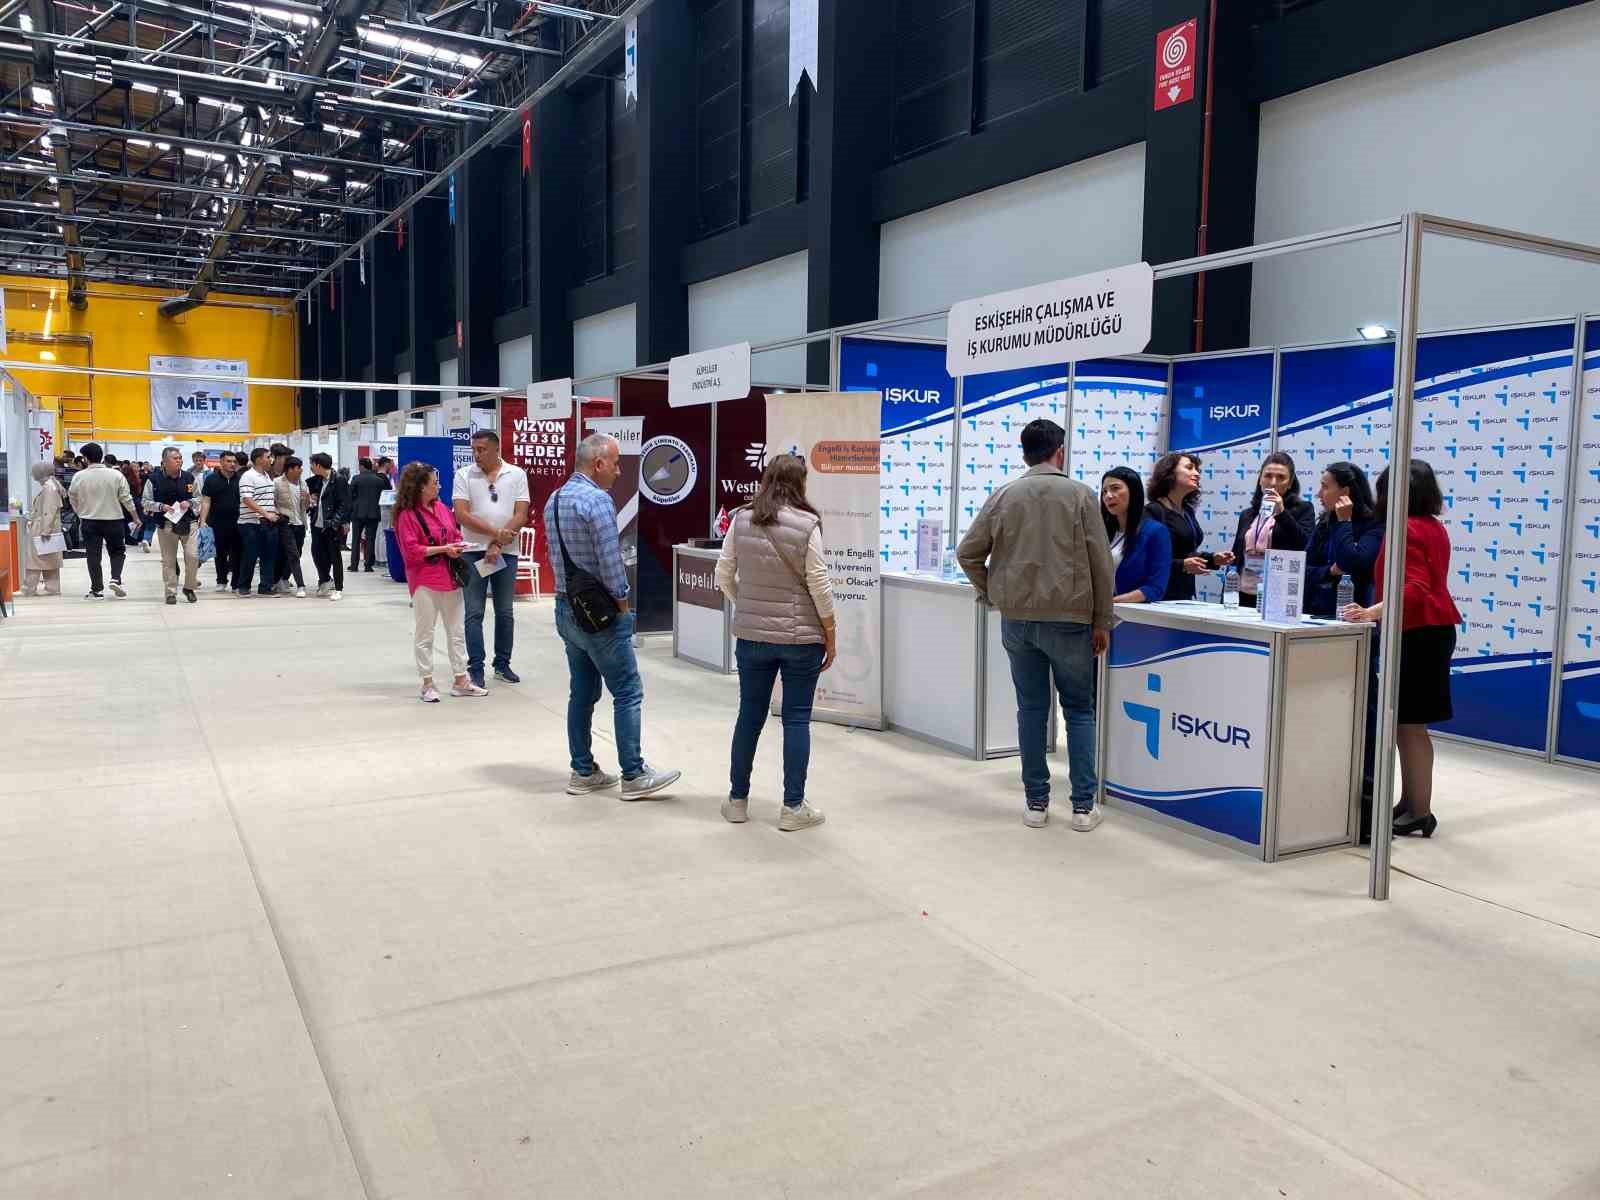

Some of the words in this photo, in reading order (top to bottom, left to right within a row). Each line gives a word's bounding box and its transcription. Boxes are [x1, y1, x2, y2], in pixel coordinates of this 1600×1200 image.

[975, 304, 1032, 331] ESKİŞEHİR
[1036, 295, 1094, 324] ÇALIŞMA
[1097, 291, 1115, 308] VE
[968, 340, 977, 359] İŞ
[980, 333, 1031, 354] KURUMU
[1034, 314, 1122, 346] MÜDÜRLÜĞÜ
[513, 416, 565, 432] VİZYON
[520, 434, 560, 444] 2030
[514, 445, 565, 458] HEDEF
[524, 456, 566, 466] MİLYON
